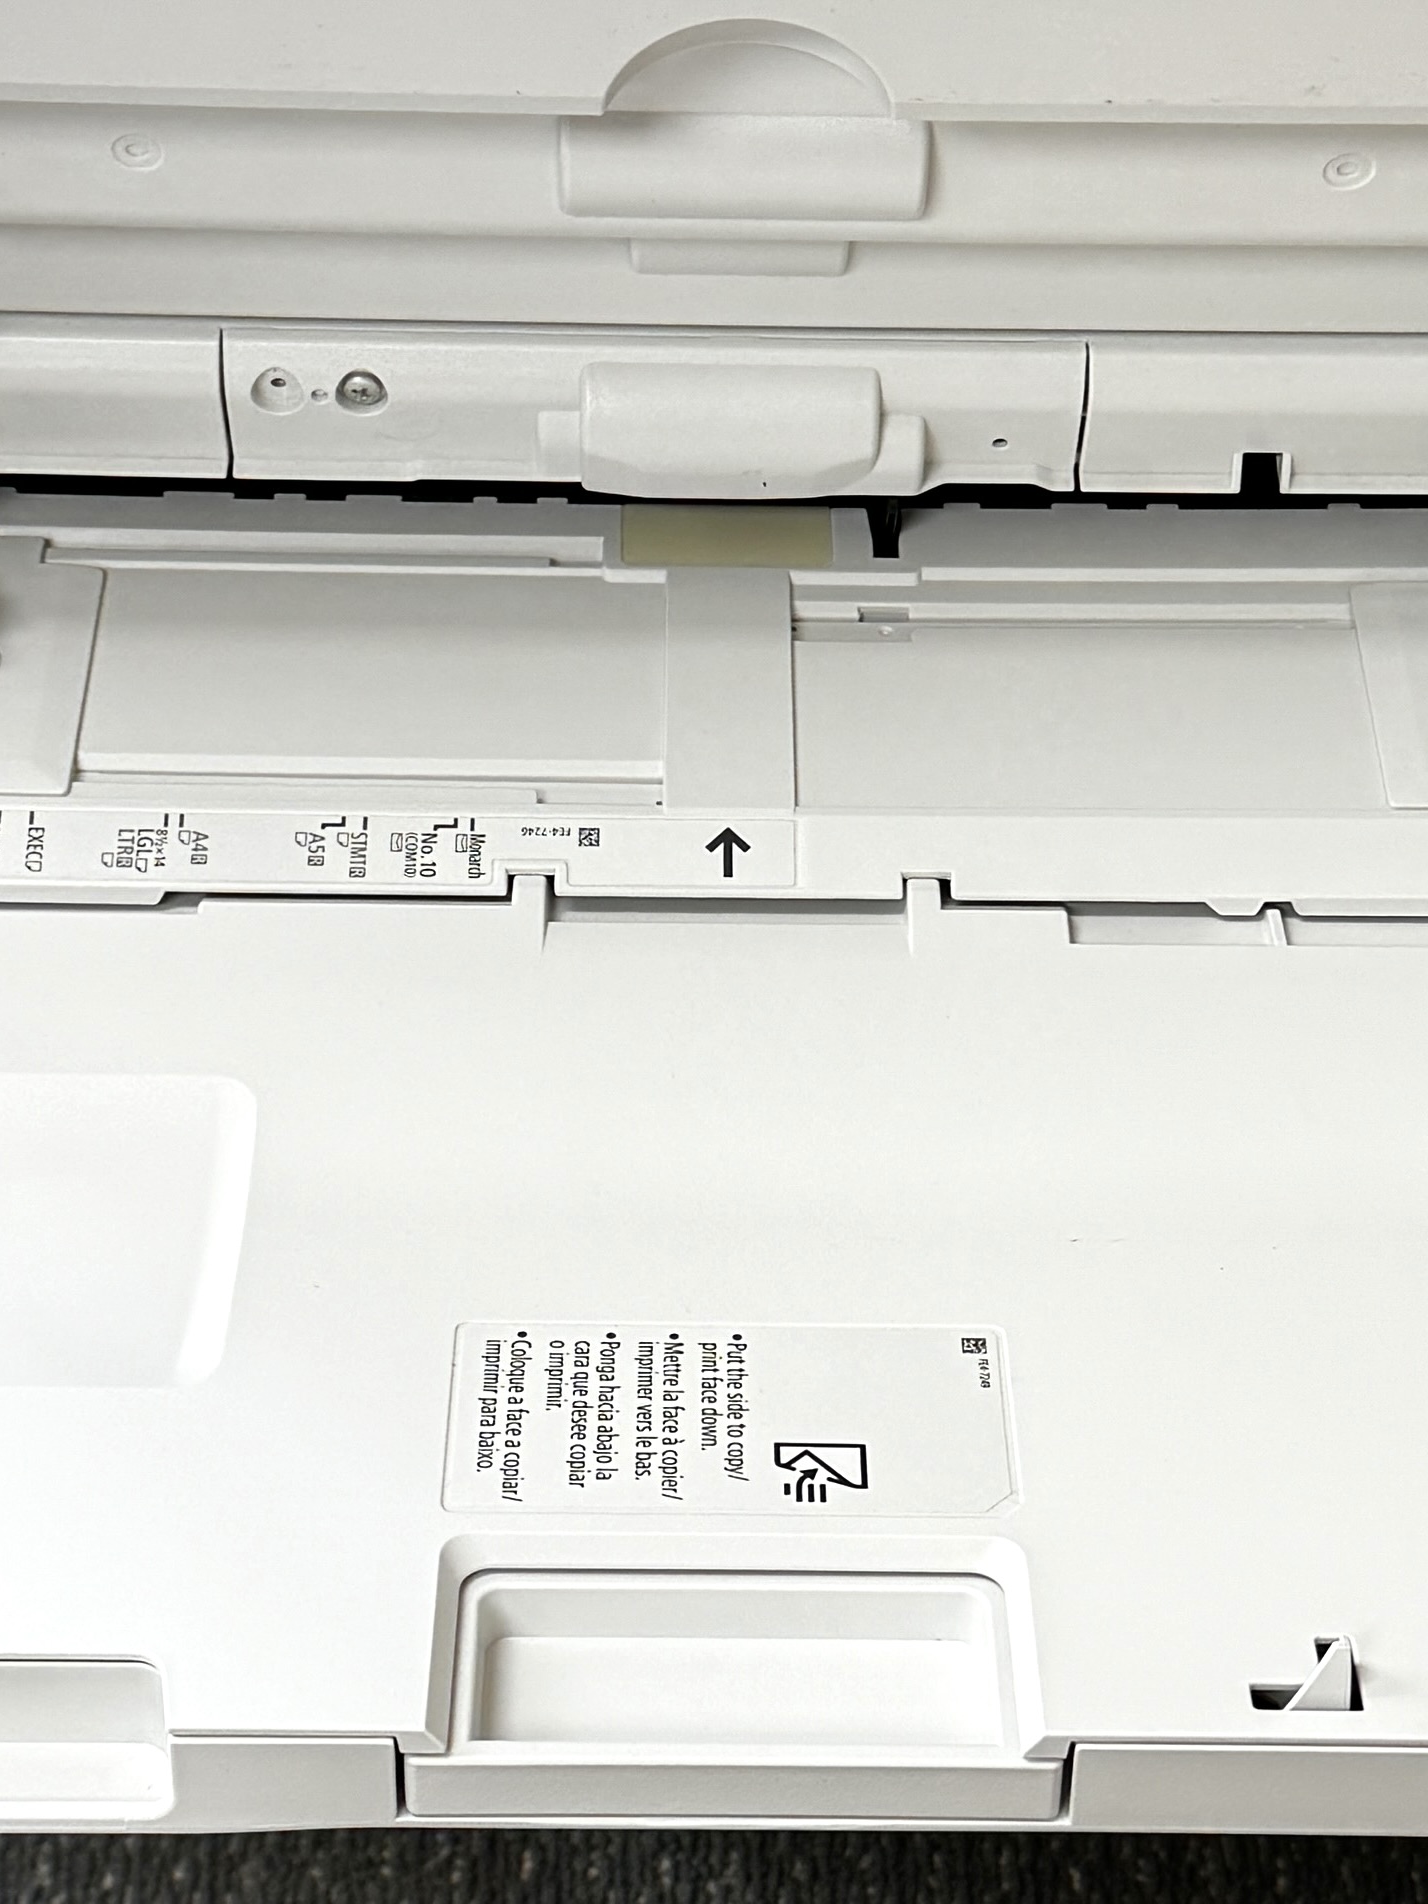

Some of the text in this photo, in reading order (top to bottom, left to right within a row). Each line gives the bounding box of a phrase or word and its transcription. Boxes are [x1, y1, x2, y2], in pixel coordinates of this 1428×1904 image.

[27, 827, 45, 861] EXEC
[136, 829, 155, 858] LGL
[467, 833, 486, 879] Monarch
[476, 1339, 508, 1473] imprimir para baixo.
[499, 1339, 533, 1502] Coloque a face a copiar/
[544, 1339, 570, 1411] o imprimir.
[565, 1340, 594, 1489] cara que desee copiar
[592, 1341, 622, 1481] Ponga hacia abajo la
[633, 1341, 660, 1481] imprimer vers le bas.
[657, 1342, 686, 1500] Mettre la face à copier/
[697, 1342, 724, 1451] print face down.
[723, 1342, 750, 1481] Put the side to copy/
